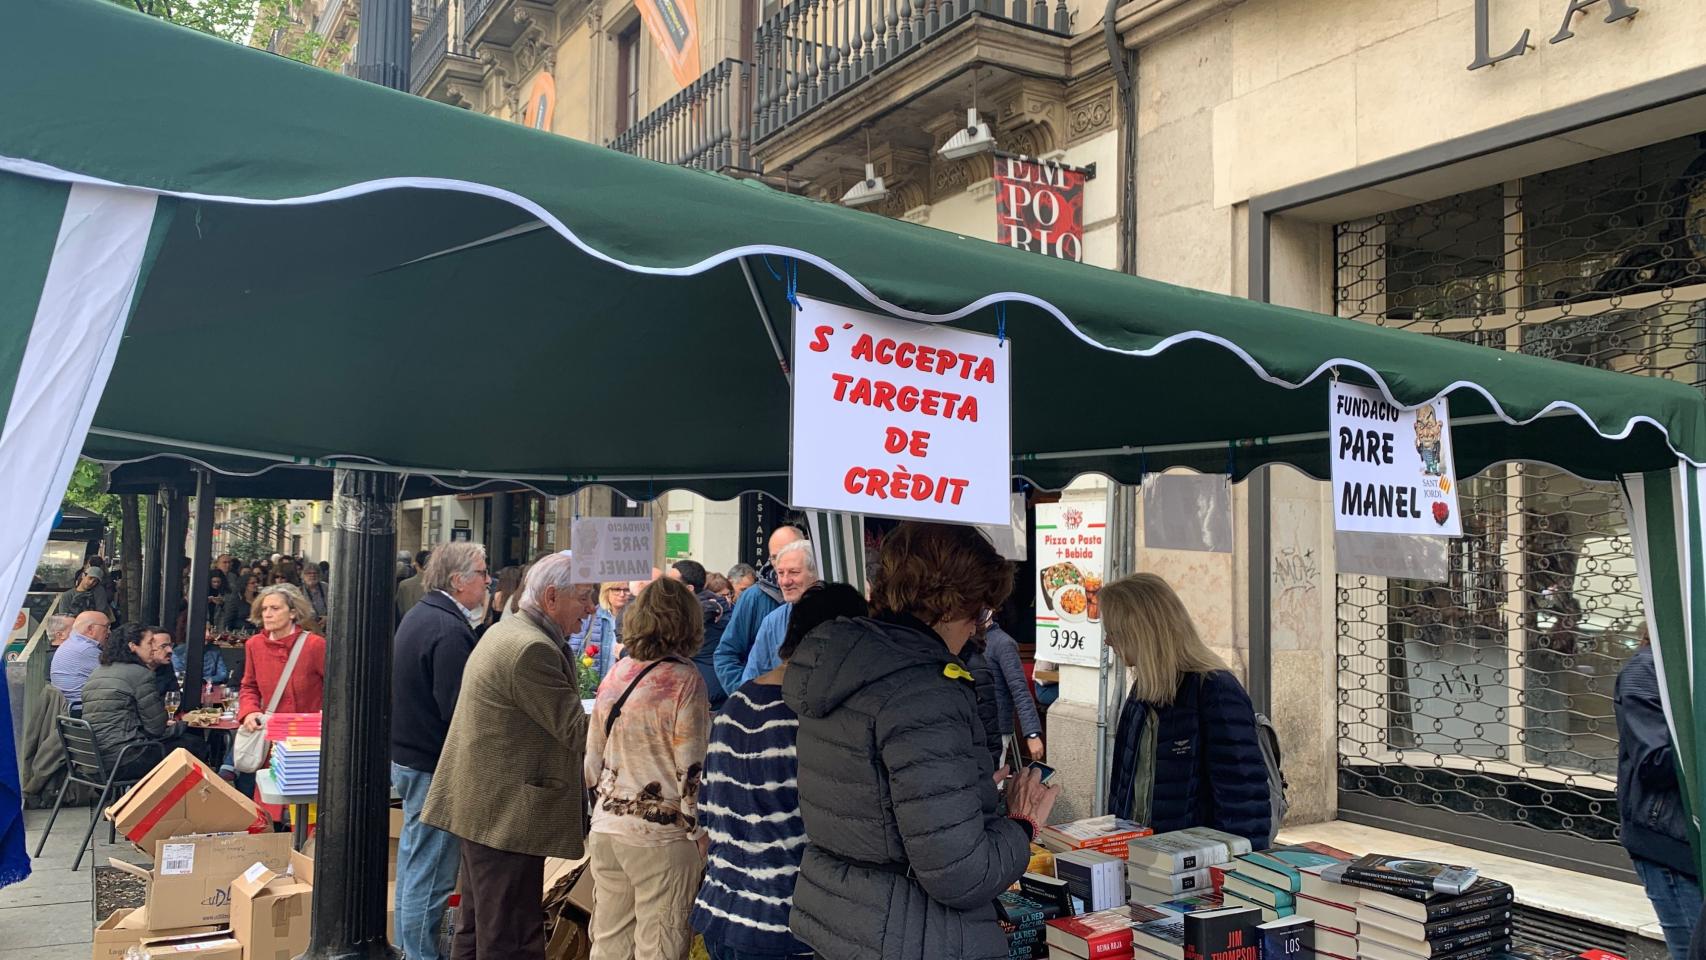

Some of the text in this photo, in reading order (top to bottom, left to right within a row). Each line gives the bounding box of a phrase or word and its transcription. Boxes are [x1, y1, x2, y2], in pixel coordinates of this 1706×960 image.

[1003, 155, 1071, 189] EM
[1003, 183, 1060, 226] PO
[1003, 223, 1082, 262] RIO
[831, 373, 978, 422] TARGETA
[884, 426, 930, 458] DE
[1339, 426, 1394, 466] PARE
[844, 464, 970, 505] CRÈDIT
[1422, 478, 1438, 488] SANT
[1341, 481, 1421, 519] MANEL
[1424, 489, 1442, 499] JORDI
[755, 492, 764, 577] ESTAURA
[1044, 534, 1102, 545] Pizza o Pasta
[1065, 548, 1093, 559] Bebida
[1049, 628, 1086, 651] 9,99€
[1022, 911, 1045, 923] LA RED
[1013, 929, 1037, 941] LA RED
[1227, 930, 1243, 949] JIM
[1008, 945, 1032, 958] LA RED
[1096, 943, 1111, 953] REINA
[1210, 945, 1257, 960] THOMPSON
[1285, 937, 1300, 955] LOS
